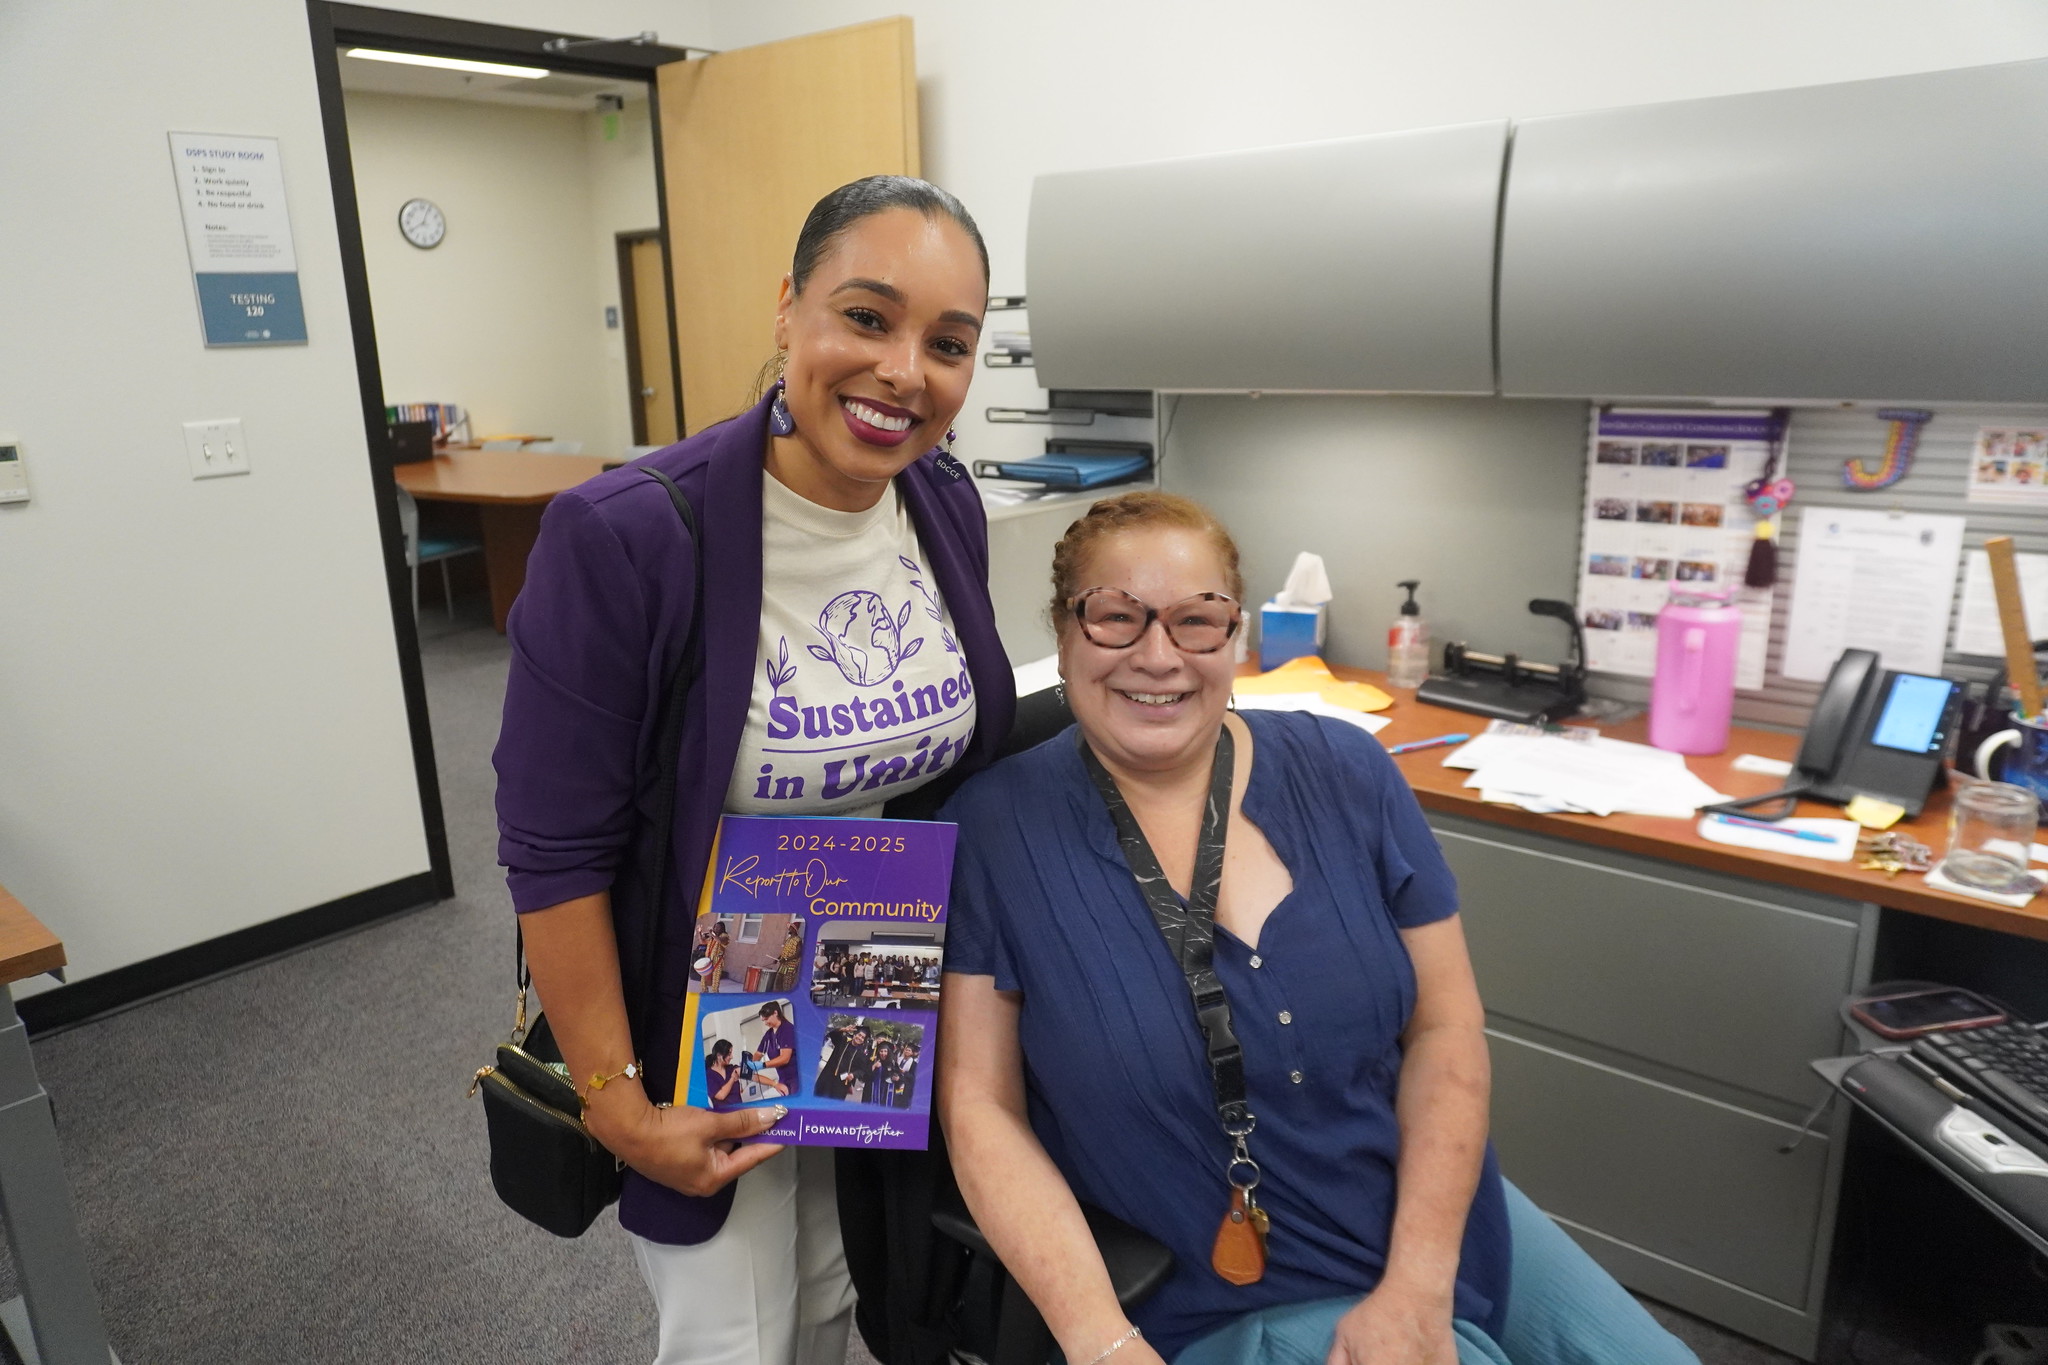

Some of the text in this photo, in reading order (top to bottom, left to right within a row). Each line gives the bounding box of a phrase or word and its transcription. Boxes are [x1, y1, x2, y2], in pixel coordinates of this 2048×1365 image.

[209, 150, 236, 159] STUDY
[238, 151, 265, 161] ROOM
[202, 166, 217, 174] Sign
[204, 177, 223, 185] Work
[225, 179, 249, 187] quietly
[217, 190, 252, 198] respectful
[230, 293, 275, 305] TESTING
[246, 306, 264, 317] 120
[772, 405, 787, 431] SDCCE
[1841, 408, 1933, 488] J
[935, 459, 961, 480] SDCCE
[767, 659, 972, 740] Sustained
[753, 763, 805, 800] in
[777, 835, 906, 853] 2024-2025
[720, 855, 788, 898] Report
[805, 858, 848, 898] Our
[809, 897, 943, 923] Community
